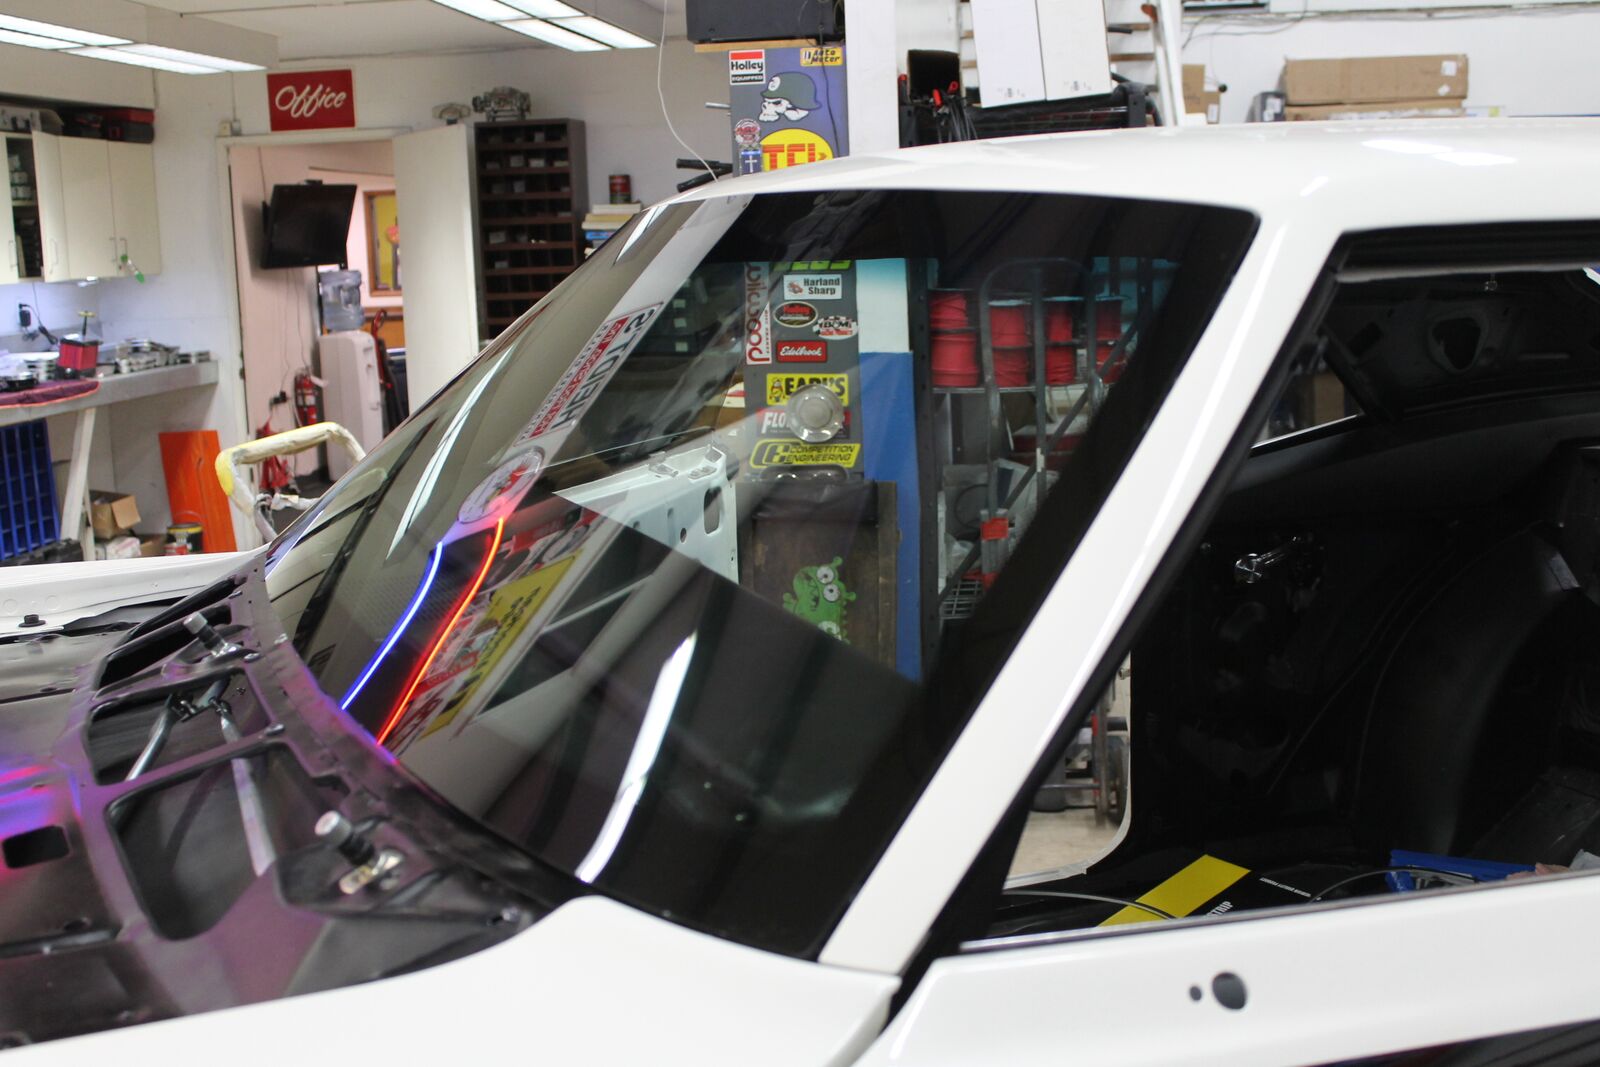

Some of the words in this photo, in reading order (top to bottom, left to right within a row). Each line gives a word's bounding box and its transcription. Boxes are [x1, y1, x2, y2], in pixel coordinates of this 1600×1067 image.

[731, 61, 763, 72] Holley
[275, 84, 347, 118] Office
[762, 143, 816, 170] TCI
[803, 277, 841, 286] Harland
[808, 286, 836, 295] Sharp
[780, 346, 822, 357] Edelbrock
[790, 445, 855, 454] COMPETITION
[786, 453, 852, 462] ENGINEERING
